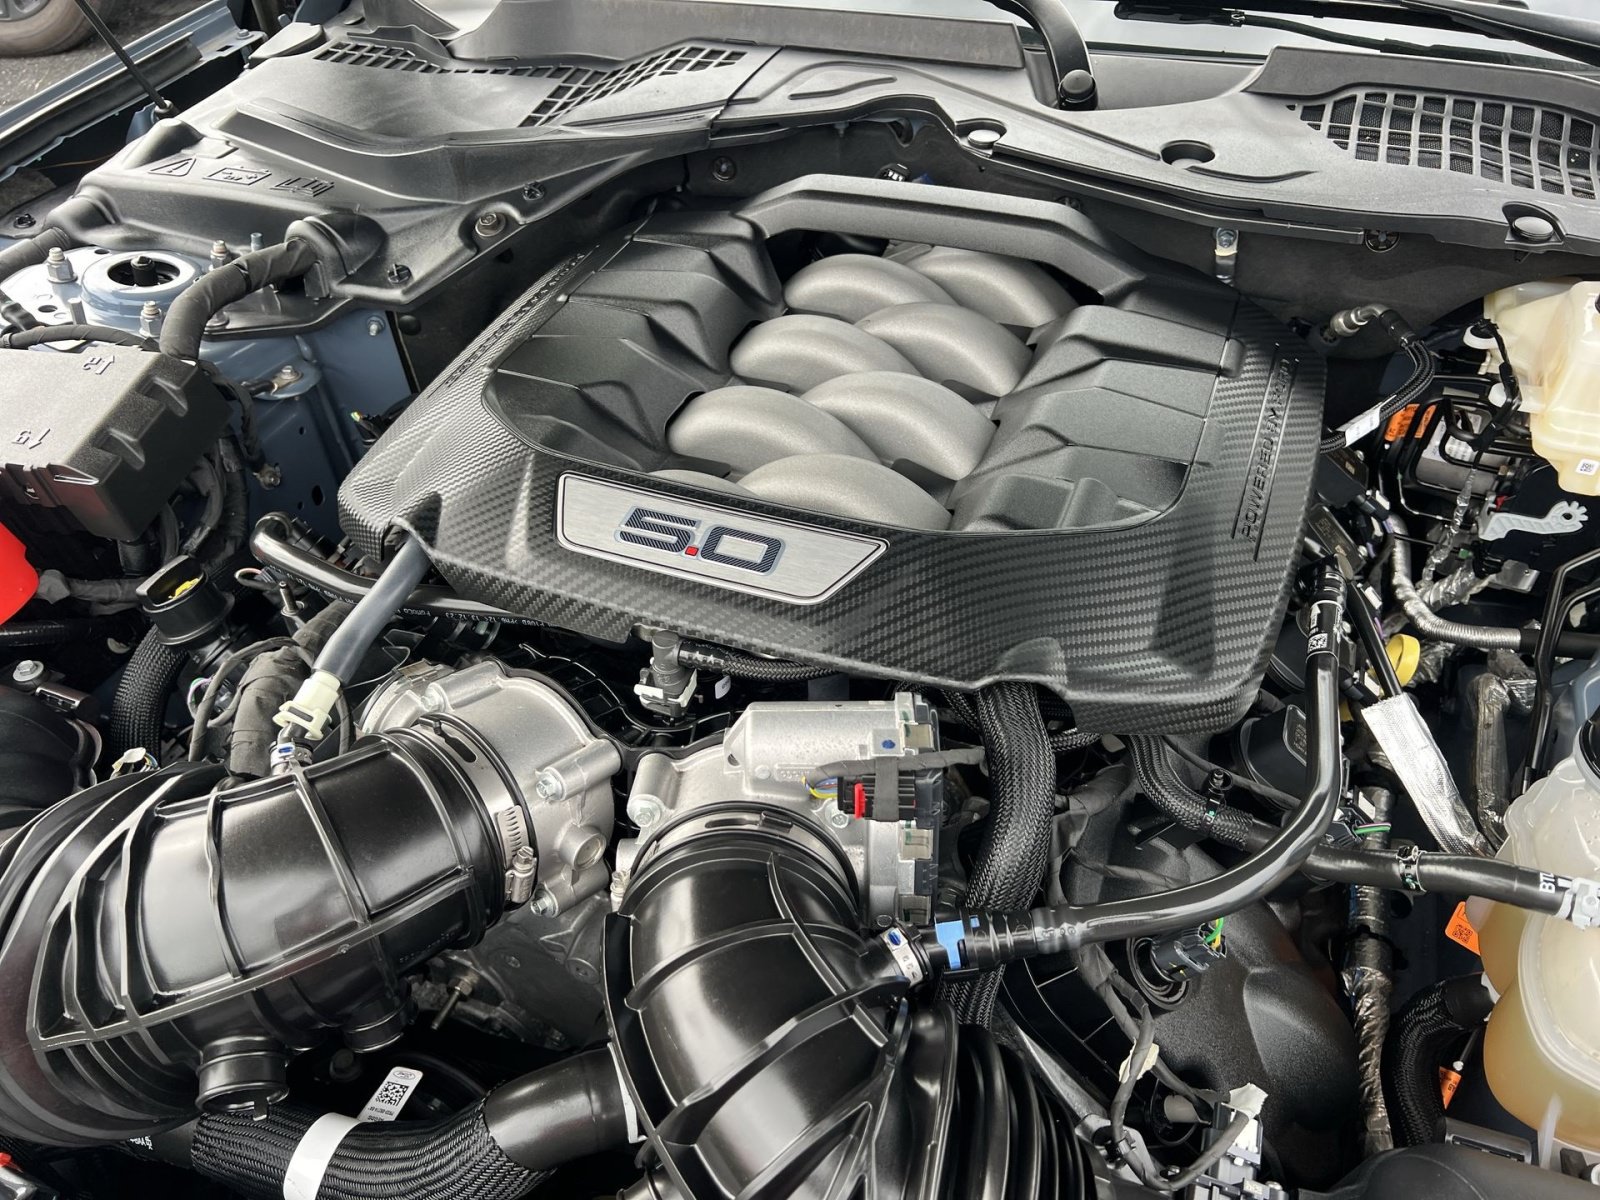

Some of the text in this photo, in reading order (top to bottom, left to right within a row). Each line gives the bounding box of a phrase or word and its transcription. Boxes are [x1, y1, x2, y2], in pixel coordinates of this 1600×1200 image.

[1242, 436, 1274, 542] POWERED
[1266, 407, 1279, 434] BY
[614, 506, 785, 576] 5.0
